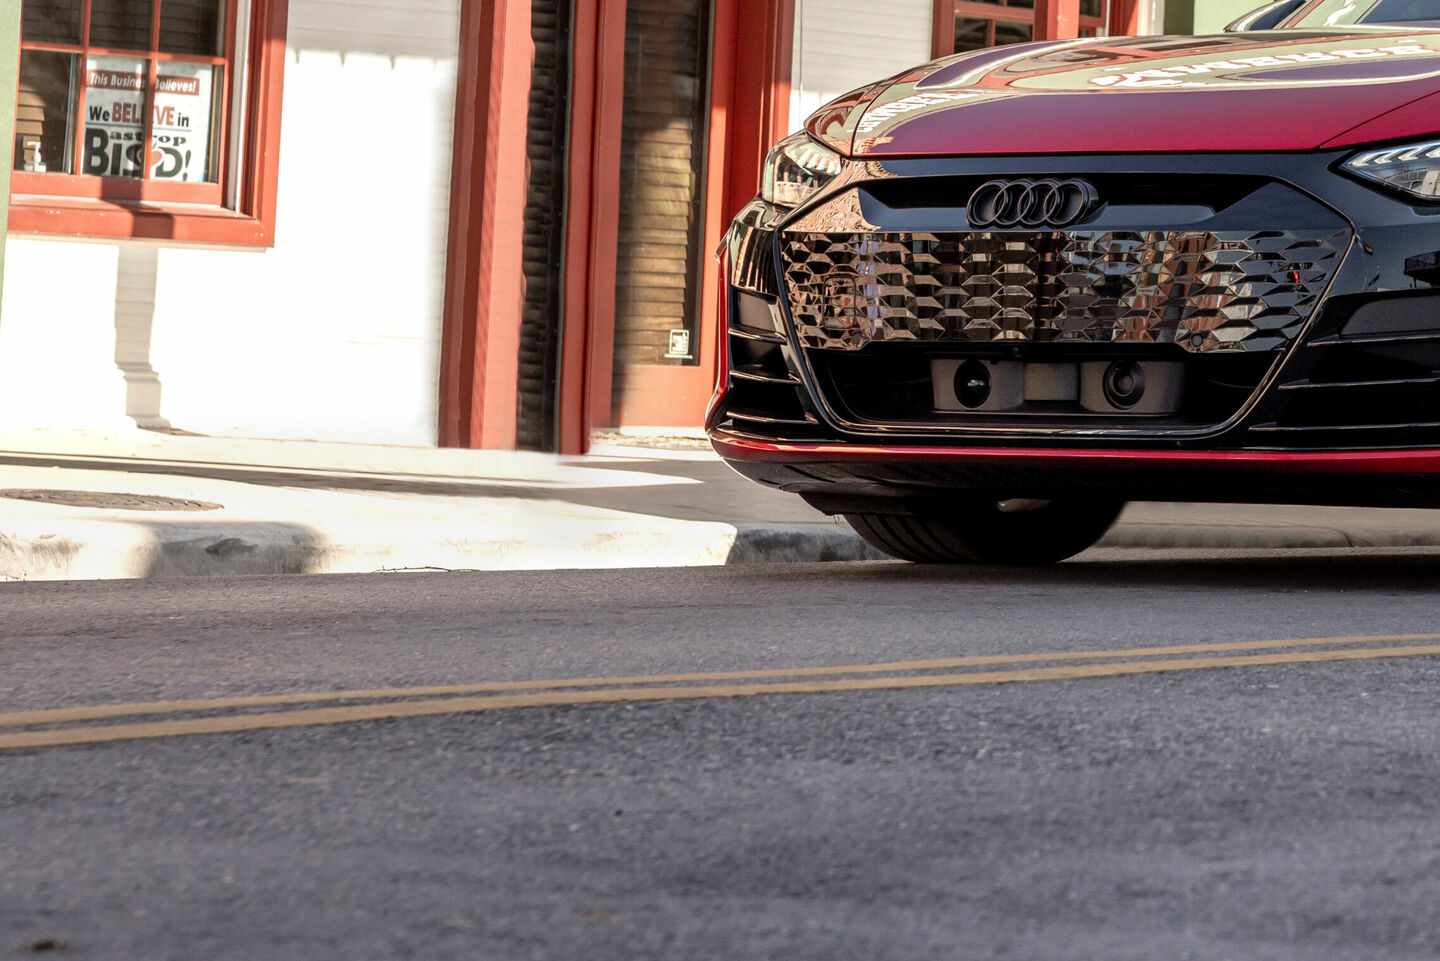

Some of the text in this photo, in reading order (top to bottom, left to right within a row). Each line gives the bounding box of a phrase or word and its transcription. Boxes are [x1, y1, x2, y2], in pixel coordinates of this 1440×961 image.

[90, 72, 107, 85] This
[89, 102, 190, 127] We BELIVE in
